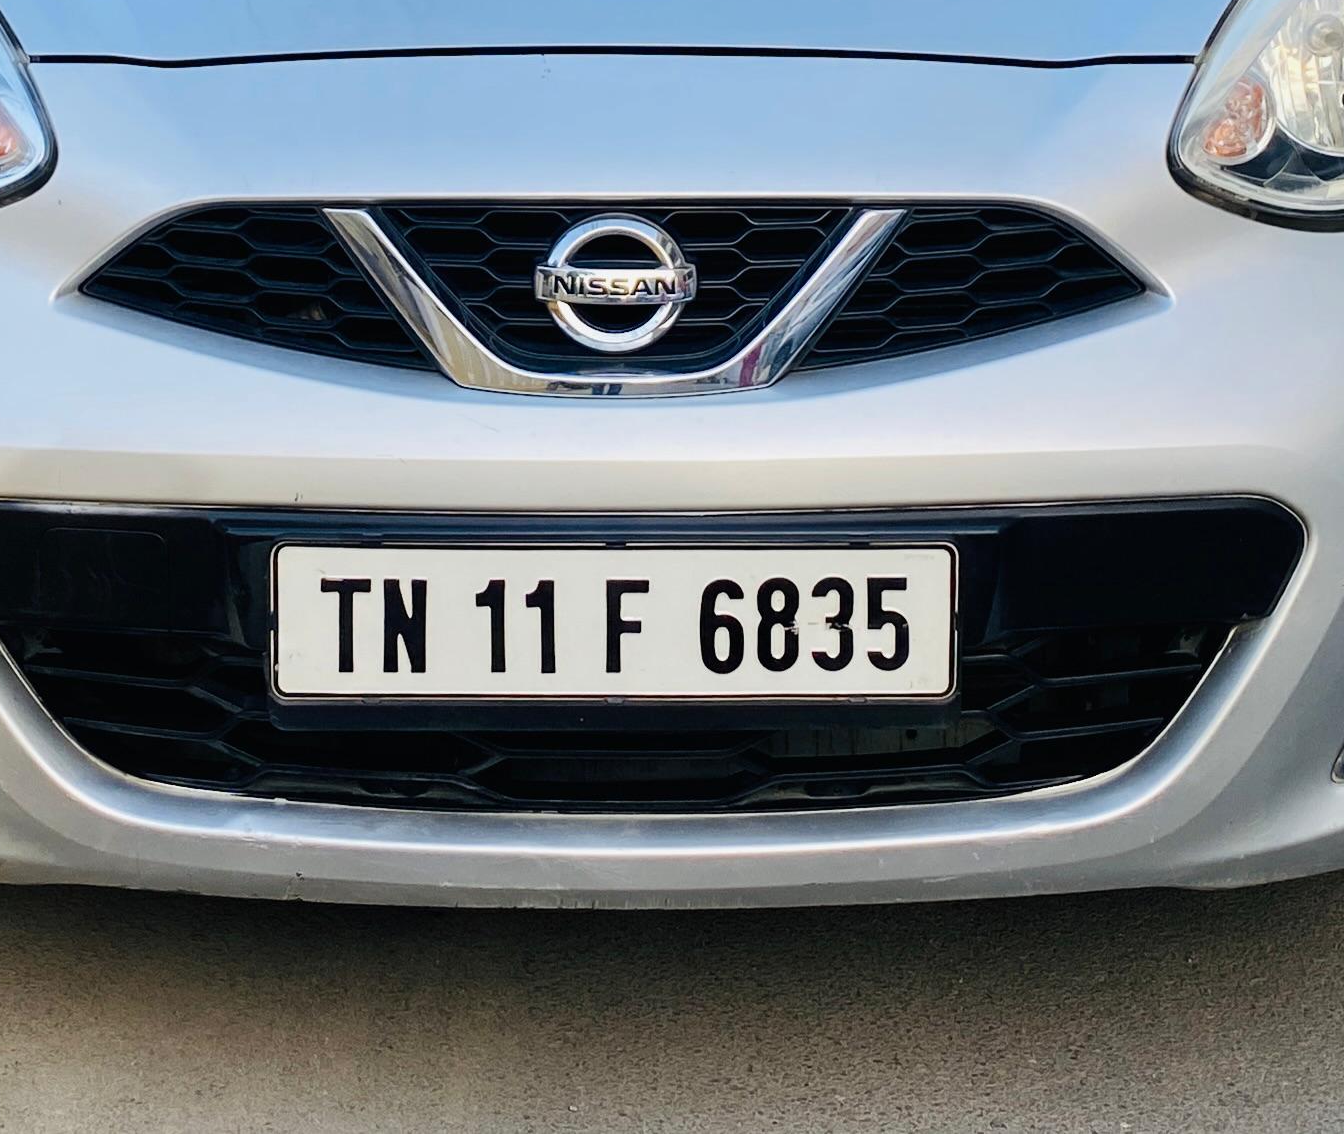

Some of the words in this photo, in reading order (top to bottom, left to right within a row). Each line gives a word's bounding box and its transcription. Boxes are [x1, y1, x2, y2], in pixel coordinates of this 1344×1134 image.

[553, 275, 677, 296] NISSAN
[321, 578, 427, 673] TN
[475, 579, 555, 674] 11
[605, 579, 649, 674] F
[699, 577, 909, 674] 6835
